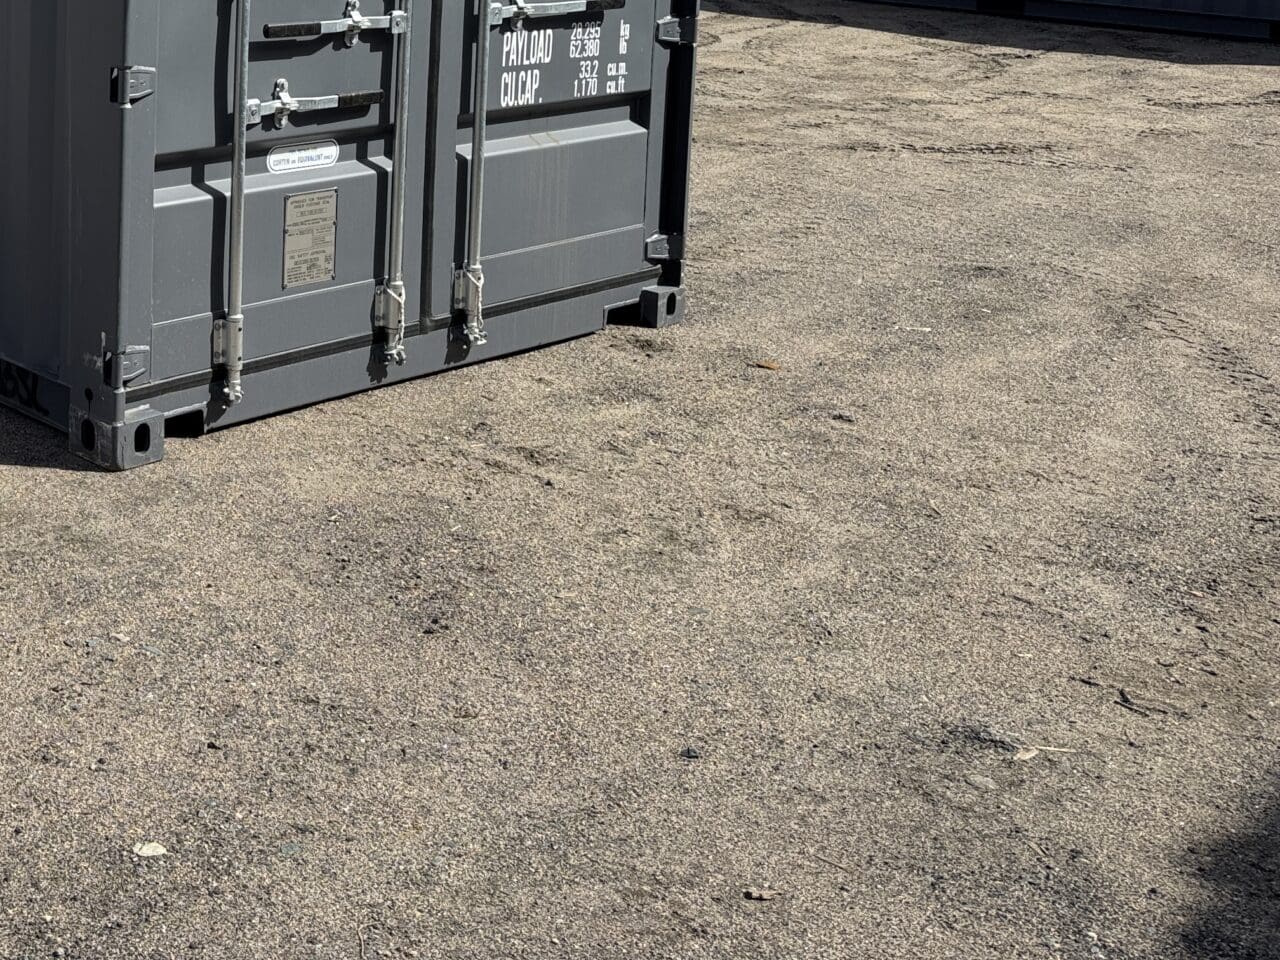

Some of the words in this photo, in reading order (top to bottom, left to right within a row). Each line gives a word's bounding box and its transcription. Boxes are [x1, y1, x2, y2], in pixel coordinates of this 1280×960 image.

[502, 29, 553, 67] PAYLOAD
[620, 20, 630, 39] kg
[619, 37, 627, 54] lb
[579, 60, 598, 78] 33.2
